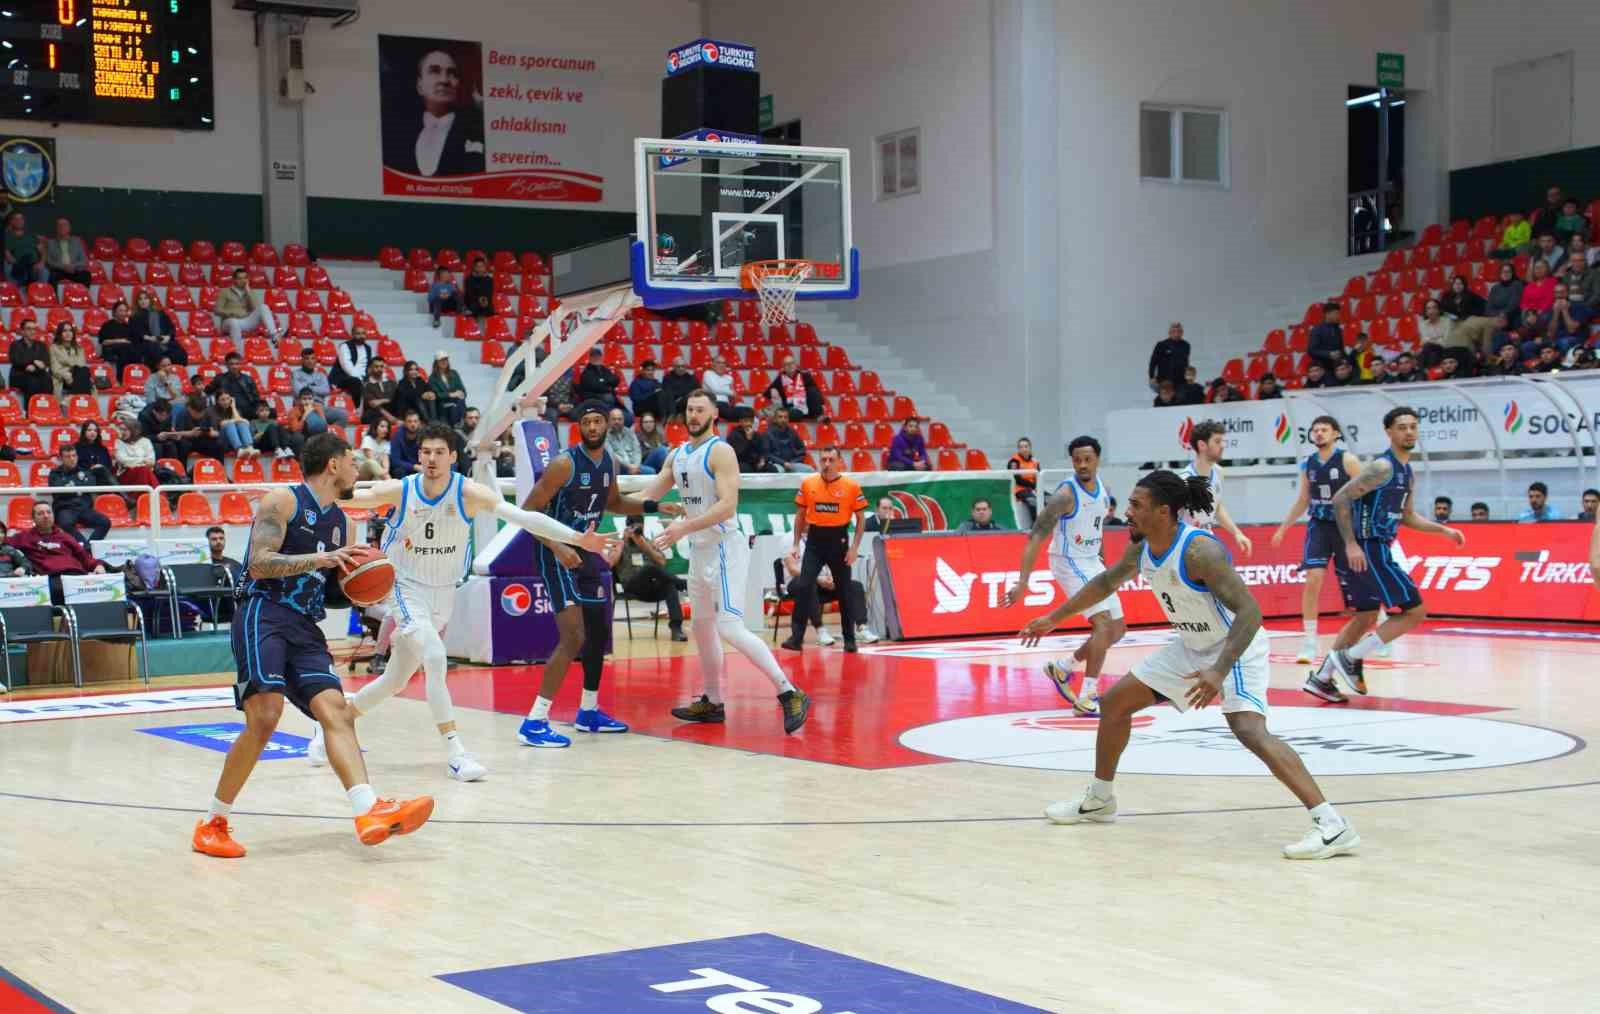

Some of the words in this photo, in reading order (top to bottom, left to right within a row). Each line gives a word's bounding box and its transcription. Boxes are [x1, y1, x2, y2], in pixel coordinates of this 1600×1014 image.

[49, 43, 55, 69] 1
[171, 50, 179, 63] 9
[488, 50, 517, 66] Ben
[519, 55, 597, 71] sporcunun
[489, 84, 523, 101] zeki,
[526, 87, 563, 103] çevik
[566, 91, 584, 103] ve
[1417, 405, 1478, 423] Petkim
[424, 522, 435, 540] 6
[1420, 555, 1502, 591] TFS
[1160, 592, 1176, 613] 3
